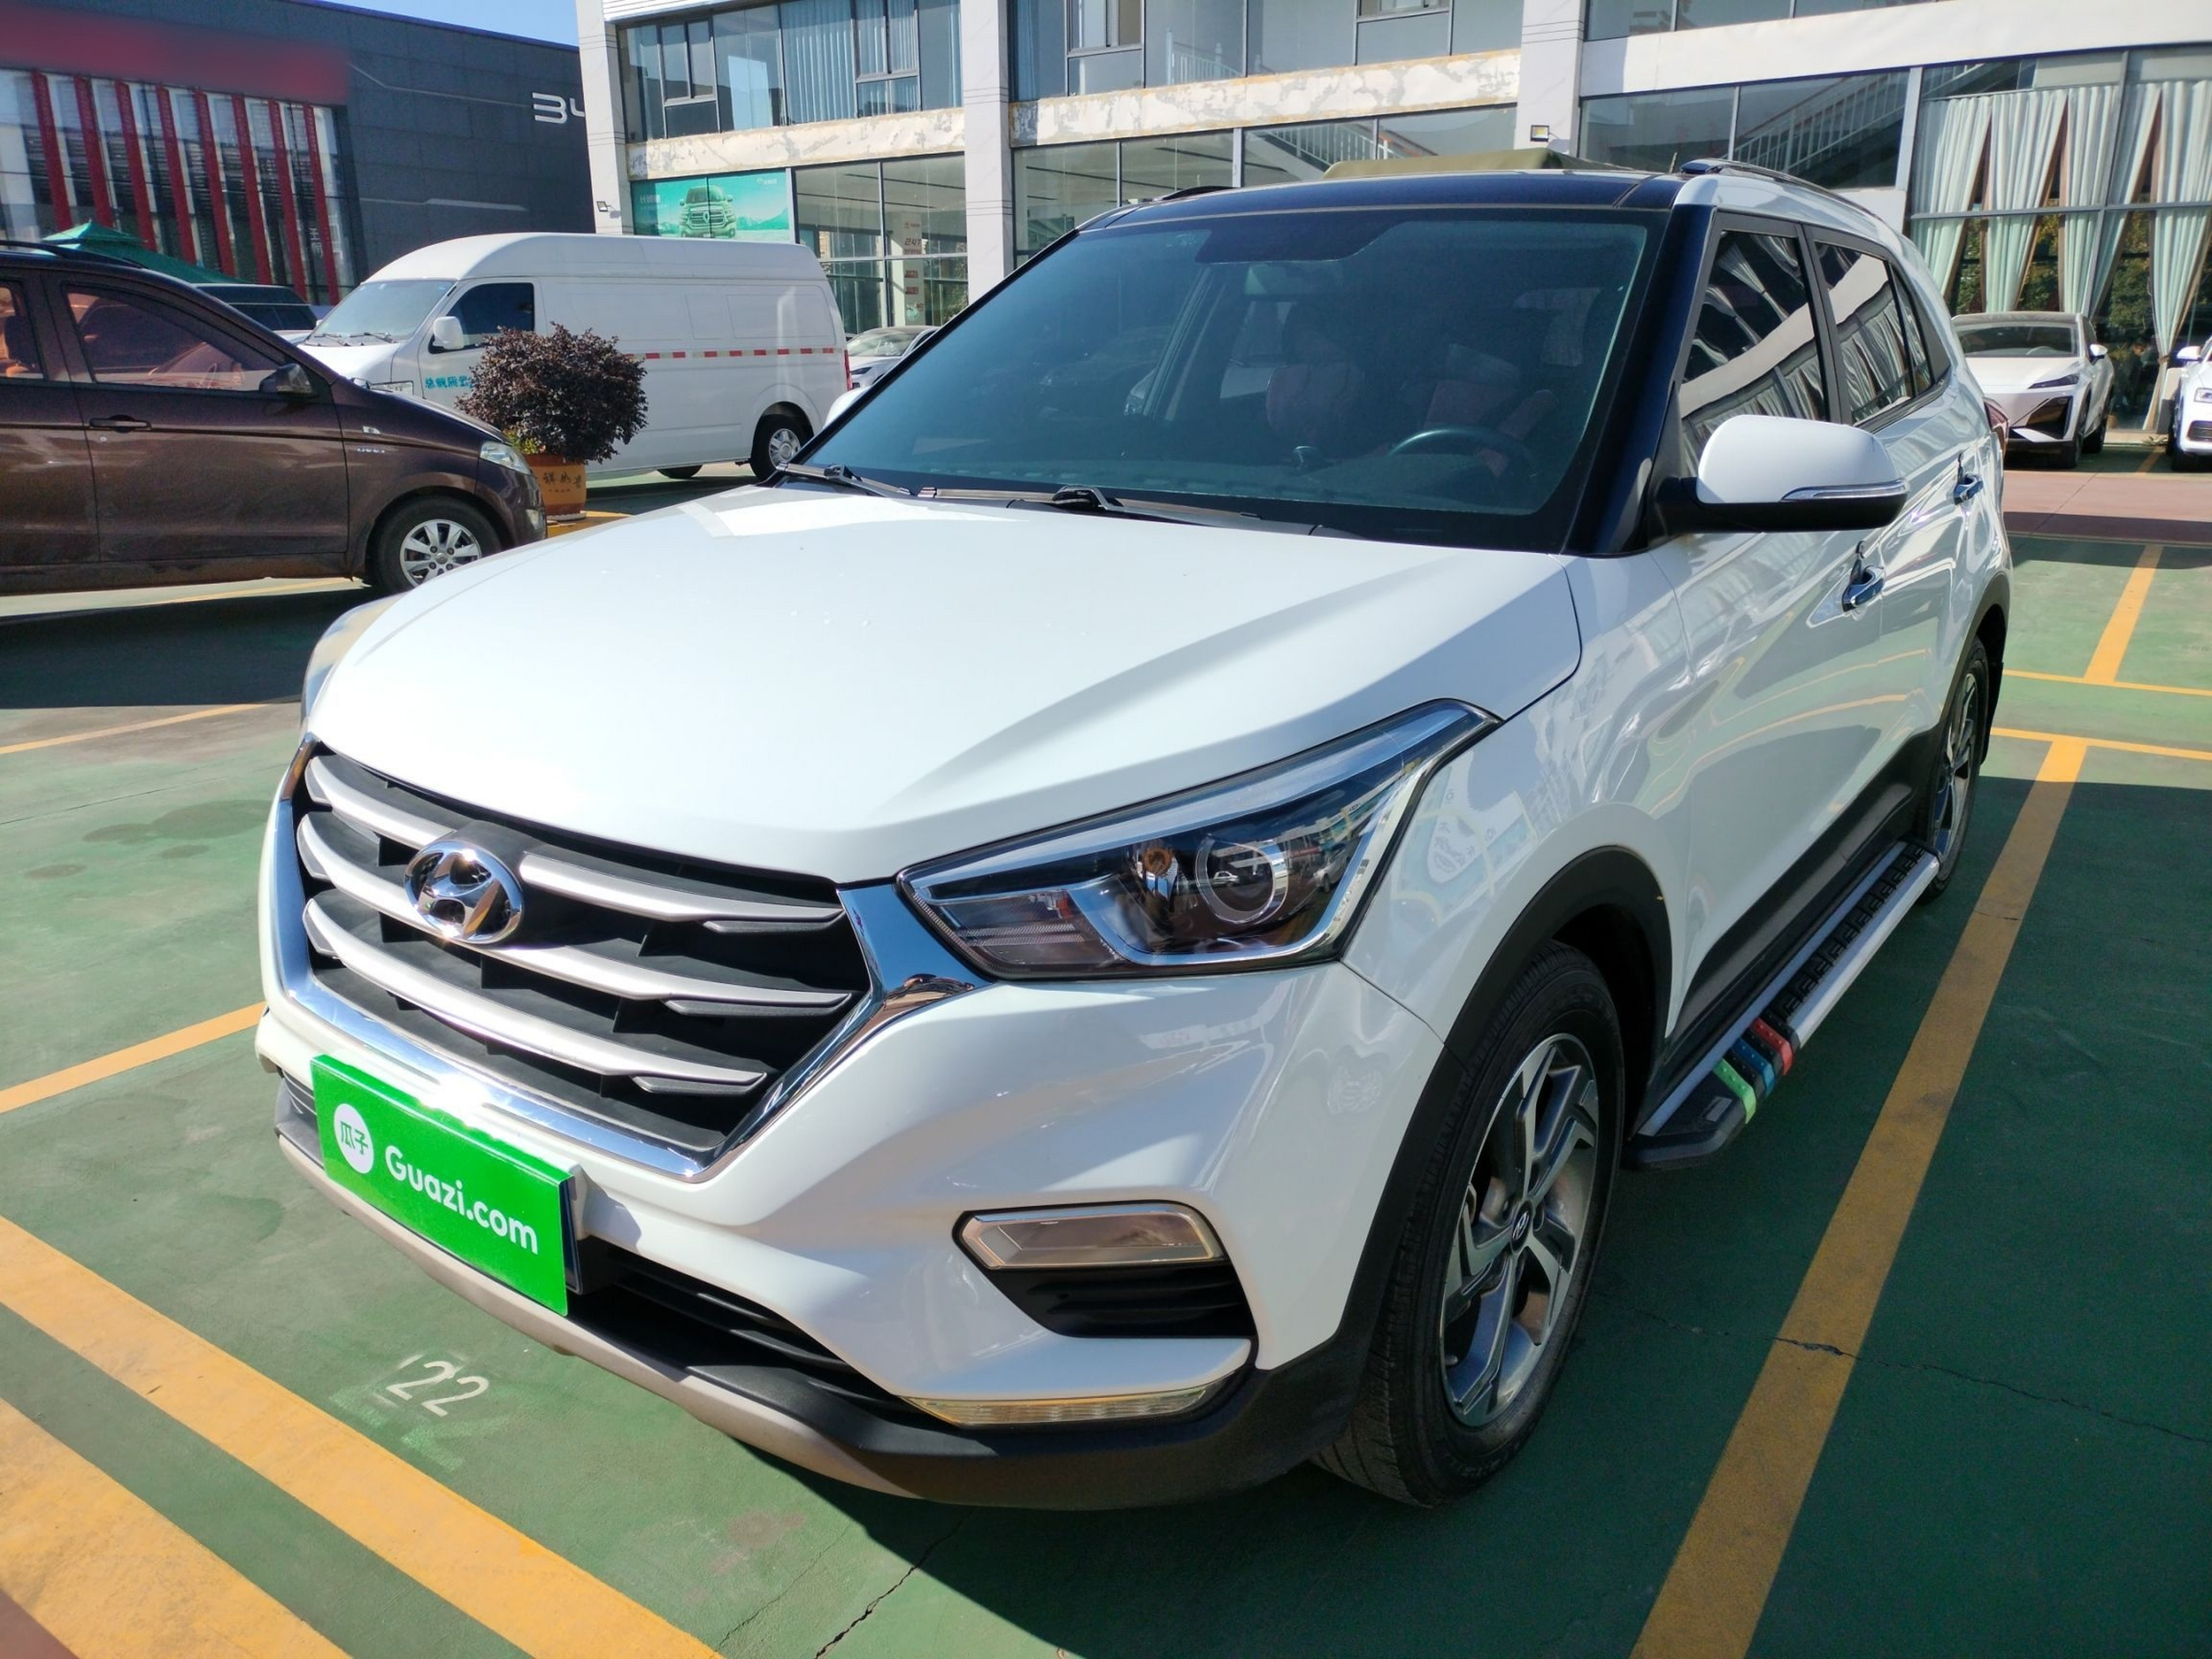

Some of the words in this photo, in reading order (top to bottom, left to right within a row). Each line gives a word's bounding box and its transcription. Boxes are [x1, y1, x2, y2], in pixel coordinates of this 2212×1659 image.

[340, 1120, 369, 1156] 瓜子
[385, 1145, 538, 1255] Guazi.com
[386, 1360, 490, 1418] 22
